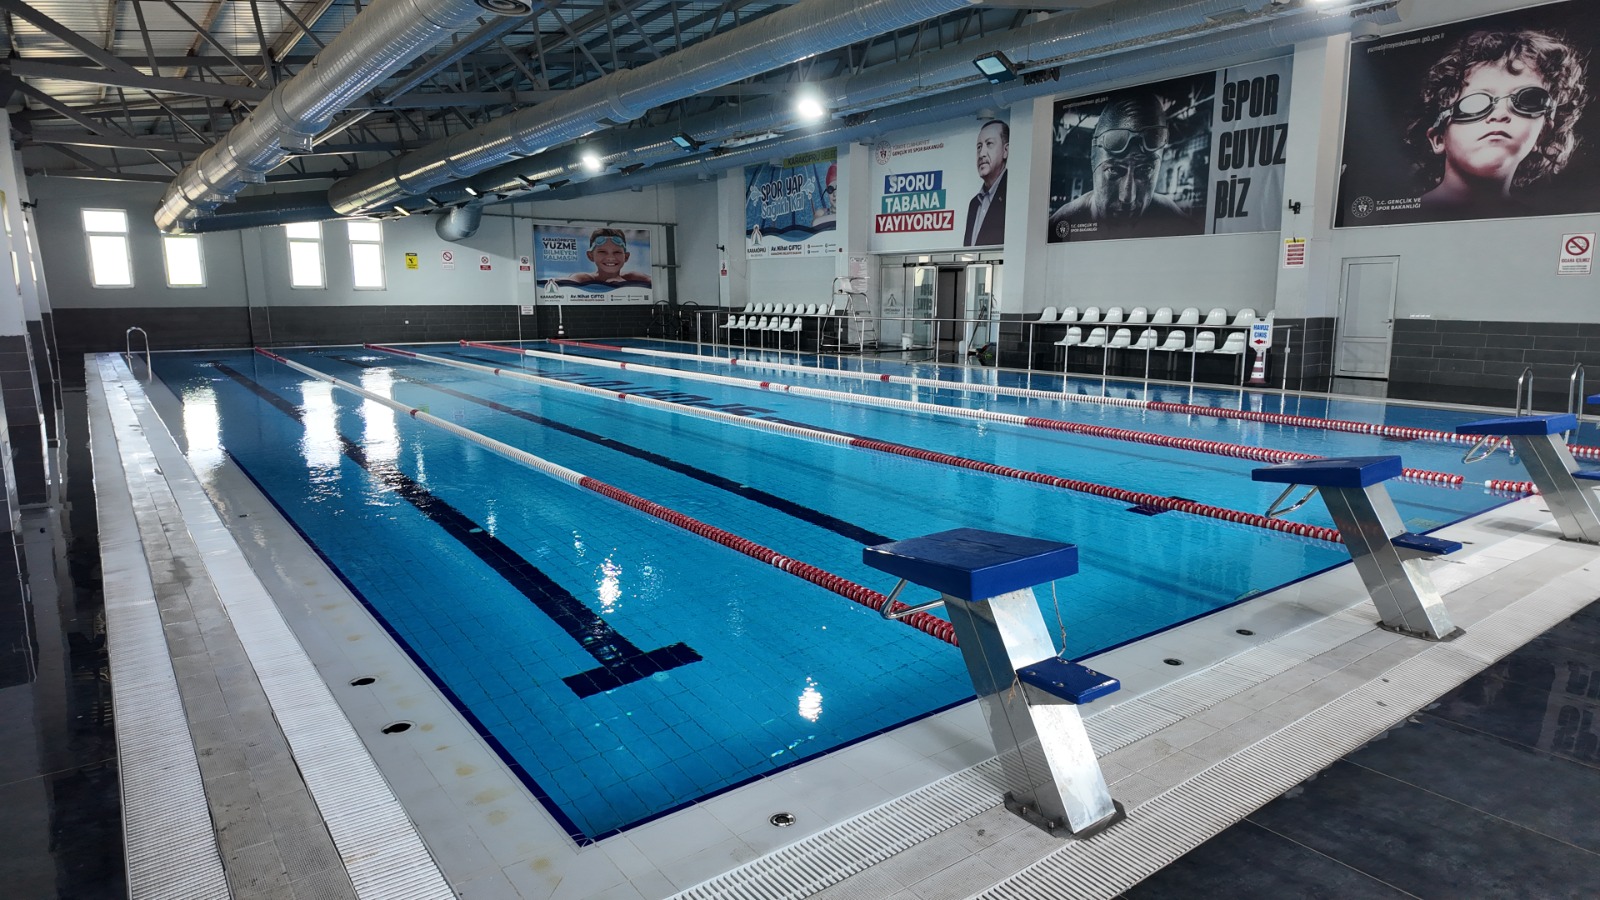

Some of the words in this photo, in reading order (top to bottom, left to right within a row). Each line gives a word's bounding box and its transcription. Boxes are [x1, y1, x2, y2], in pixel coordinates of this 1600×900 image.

[1221, 74, 1280, 122] SPOR
[1218, 123, 1288, 171] CUYUZ
[761, 180, 784, 202] SPOR
[785, 174, 804, 196] YAP
[889, 174, 935, 193] SPORU
[790, 192, 805, 212] Kal
[885, 192, 940, 213] TABANA
[1215, 175, 1251, 218] BİZ
[878, 212, 952, 231] YAYIYORUZ
